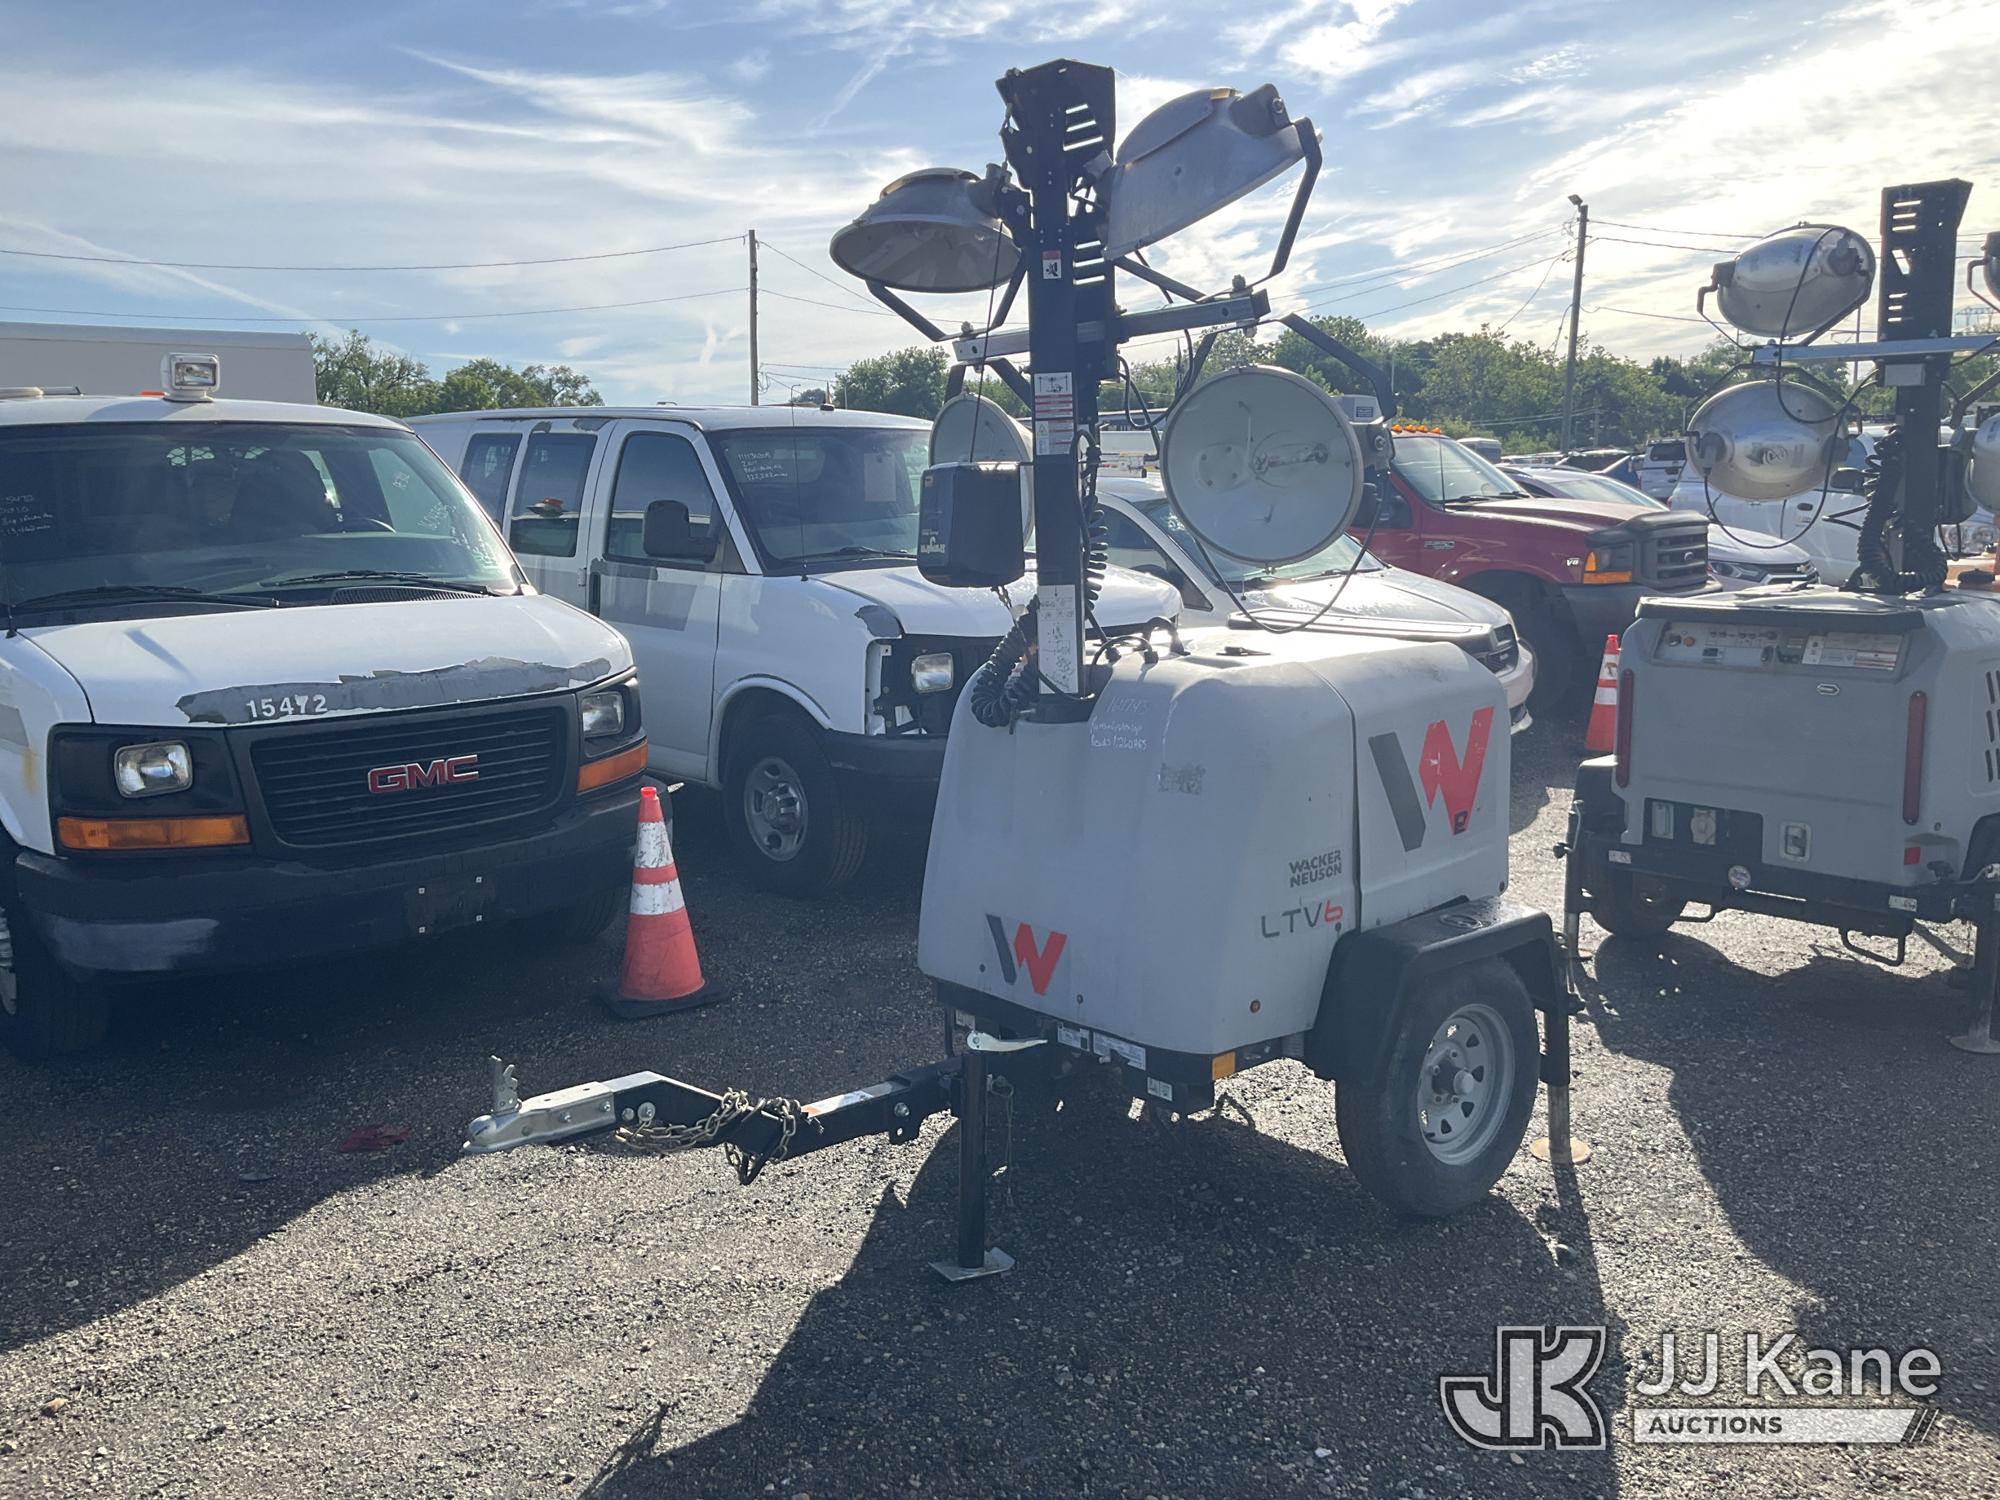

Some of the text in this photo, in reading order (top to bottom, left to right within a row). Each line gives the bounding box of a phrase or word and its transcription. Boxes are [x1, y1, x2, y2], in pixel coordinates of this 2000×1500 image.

[246, 694, 328, 718] 15472
[368, 754, 479, 794] GMC
[1288, 849, 1342, 874] WACKER
[1290, 862, 1342, 888] NEUSON
[1261, 899, 1344, 938] LTV6
